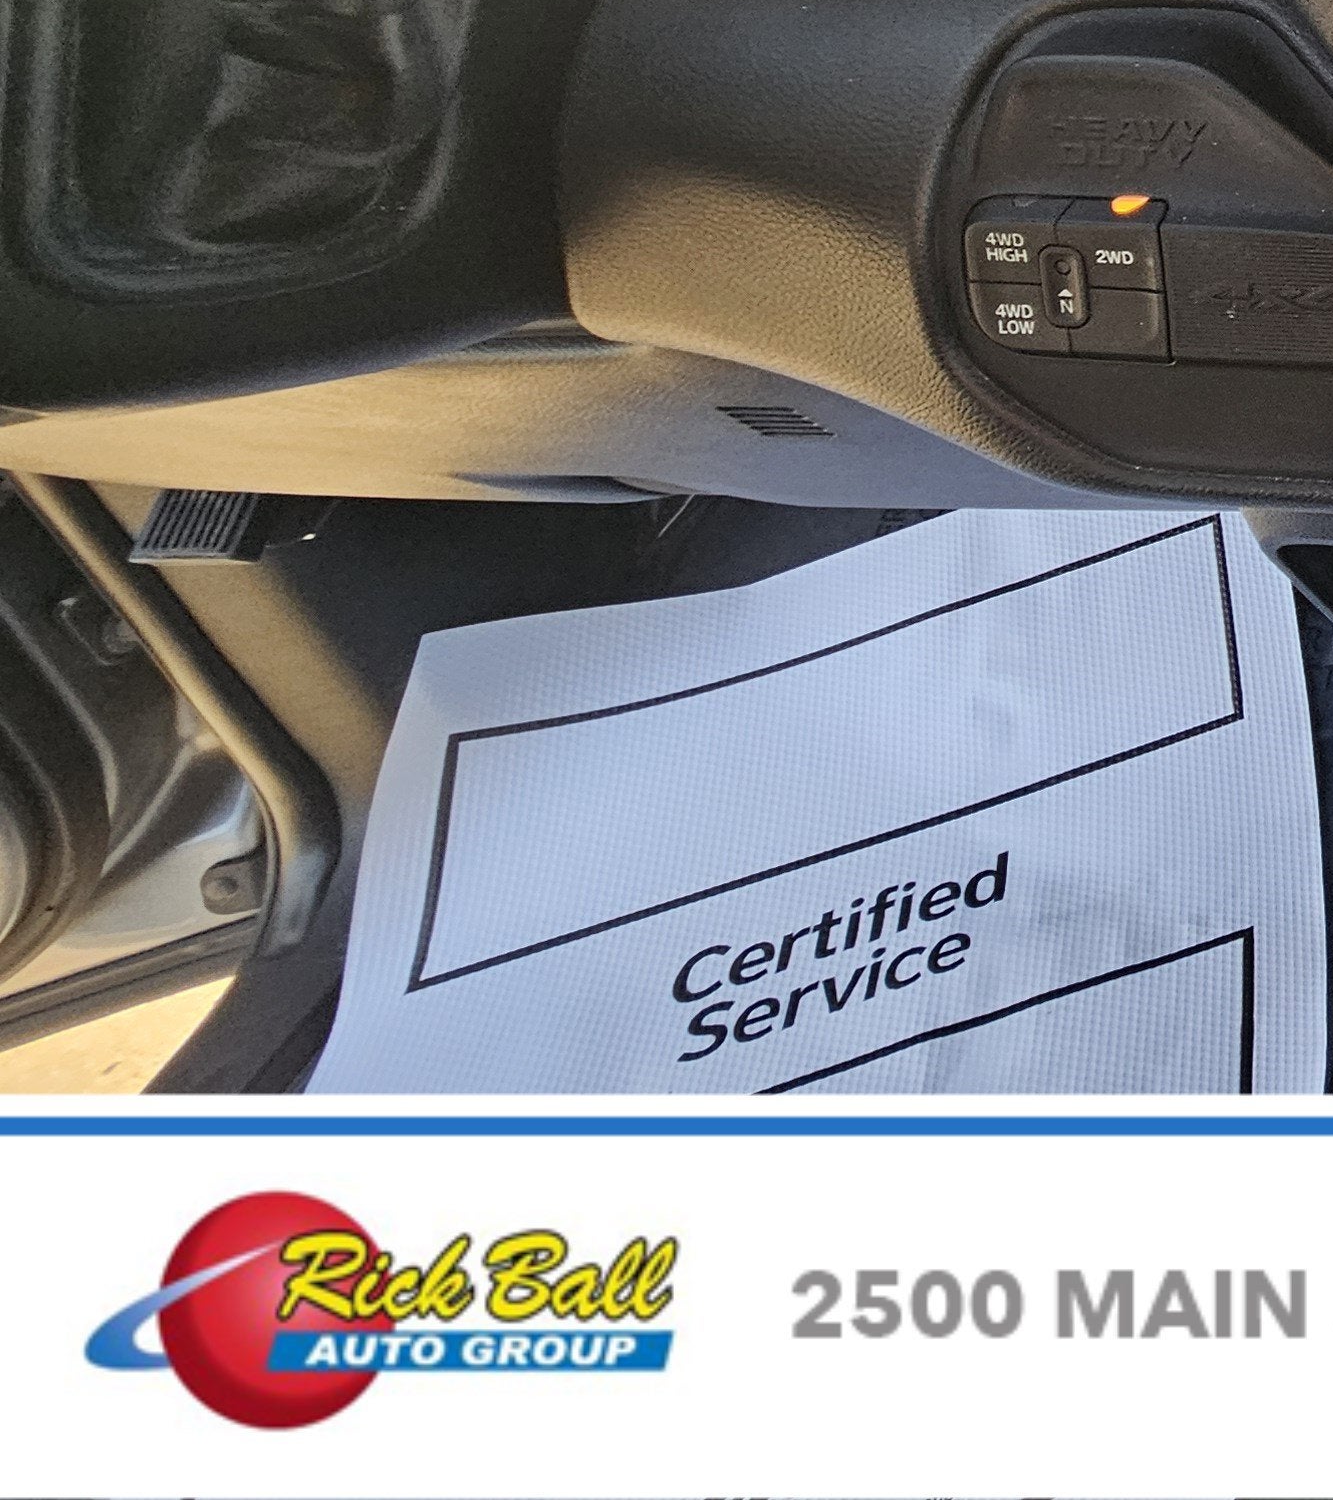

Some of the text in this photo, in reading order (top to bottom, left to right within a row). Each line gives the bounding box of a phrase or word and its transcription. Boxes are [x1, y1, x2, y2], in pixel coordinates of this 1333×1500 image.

[1050, 116, 1209, 143] HEAVY
[1057, 142, 1196, 170] DUTY
[985, 232, 1025, 248] 4WD
[985, 247, 1028, 264] HIGH
[1094, 249, 1135, 266] 2WD
[995, 304, 1034, 319] 4WD
[1059, 300, 1074, 315] N
[998, 319, 1035, 336] LOW
[672, 850, 1010, 1004] Certified
[677, 932, 972, 1063] Service
